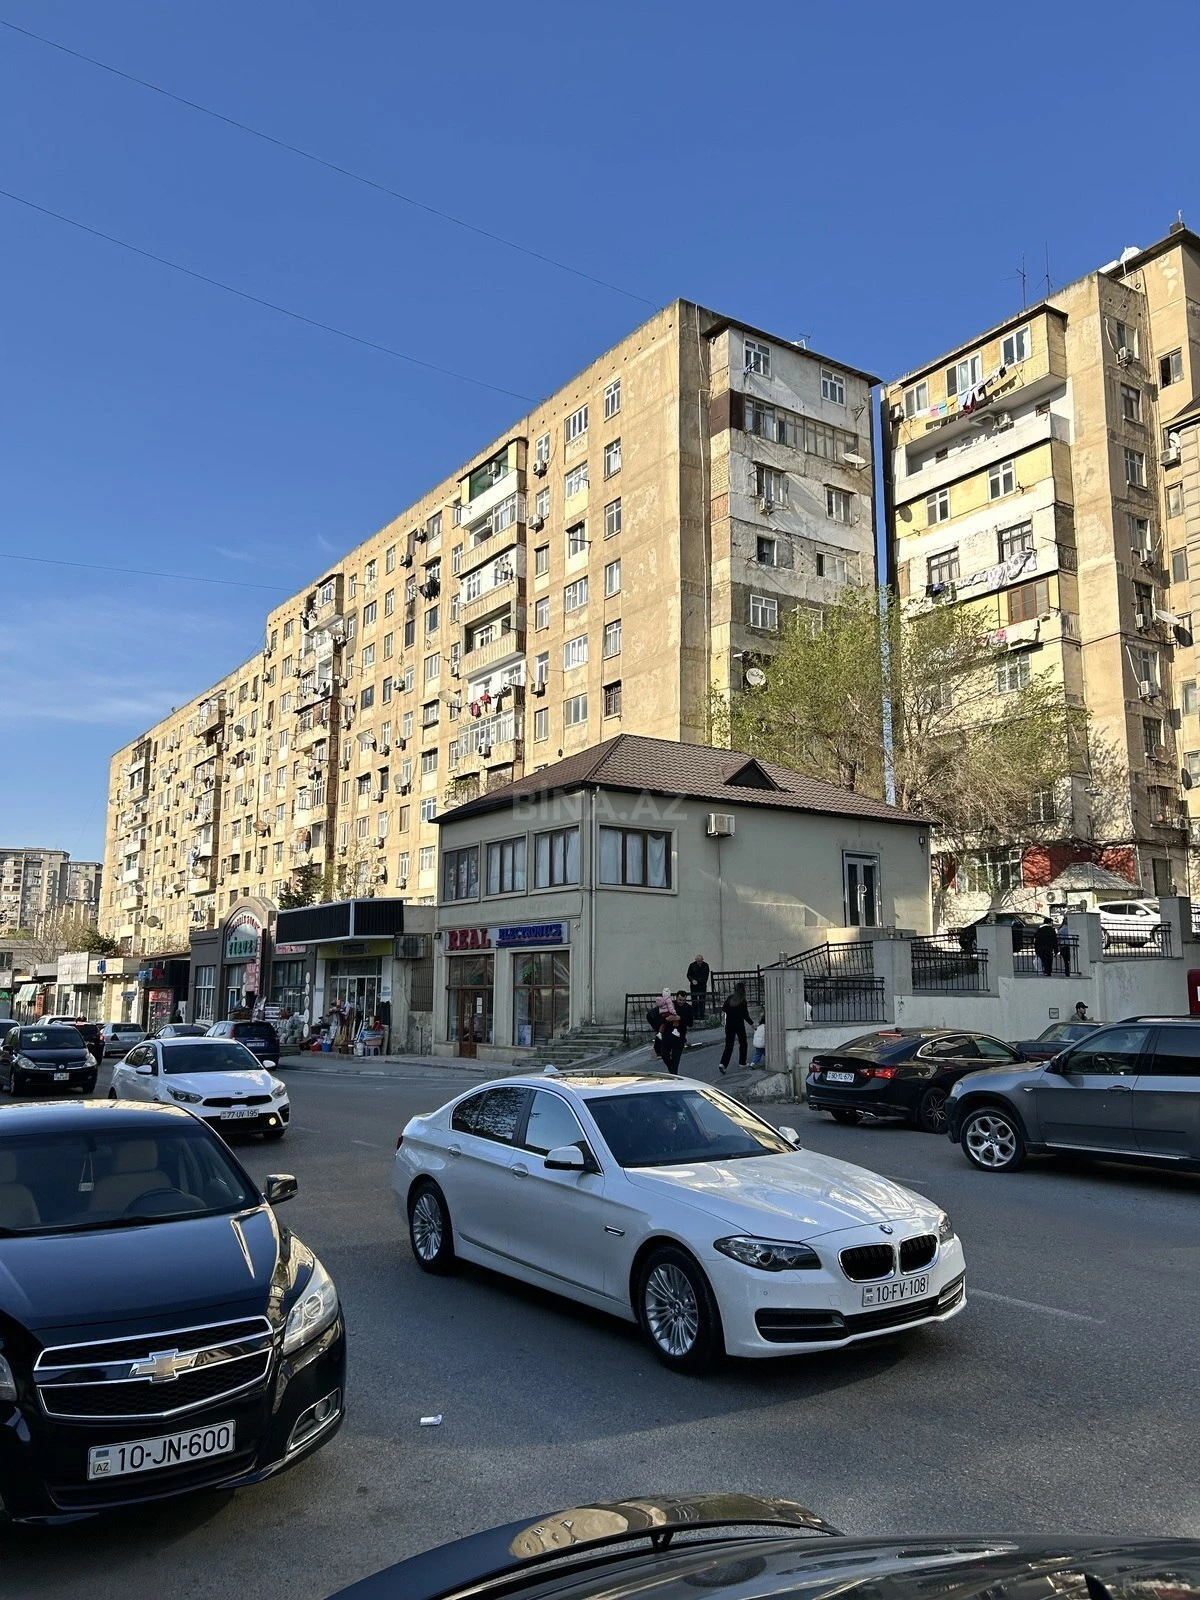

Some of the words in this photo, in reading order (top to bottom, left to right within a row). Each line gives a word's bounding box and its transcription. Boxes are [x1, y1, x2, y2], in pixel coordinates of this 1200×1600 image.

[448, 928, 491, 950] REAL
[876, 1277, 926, 1303] 10-FV-108
[118, 1426, 230, 1471] 10-JN-600
[95, 1463, 109, 1472] AZ
